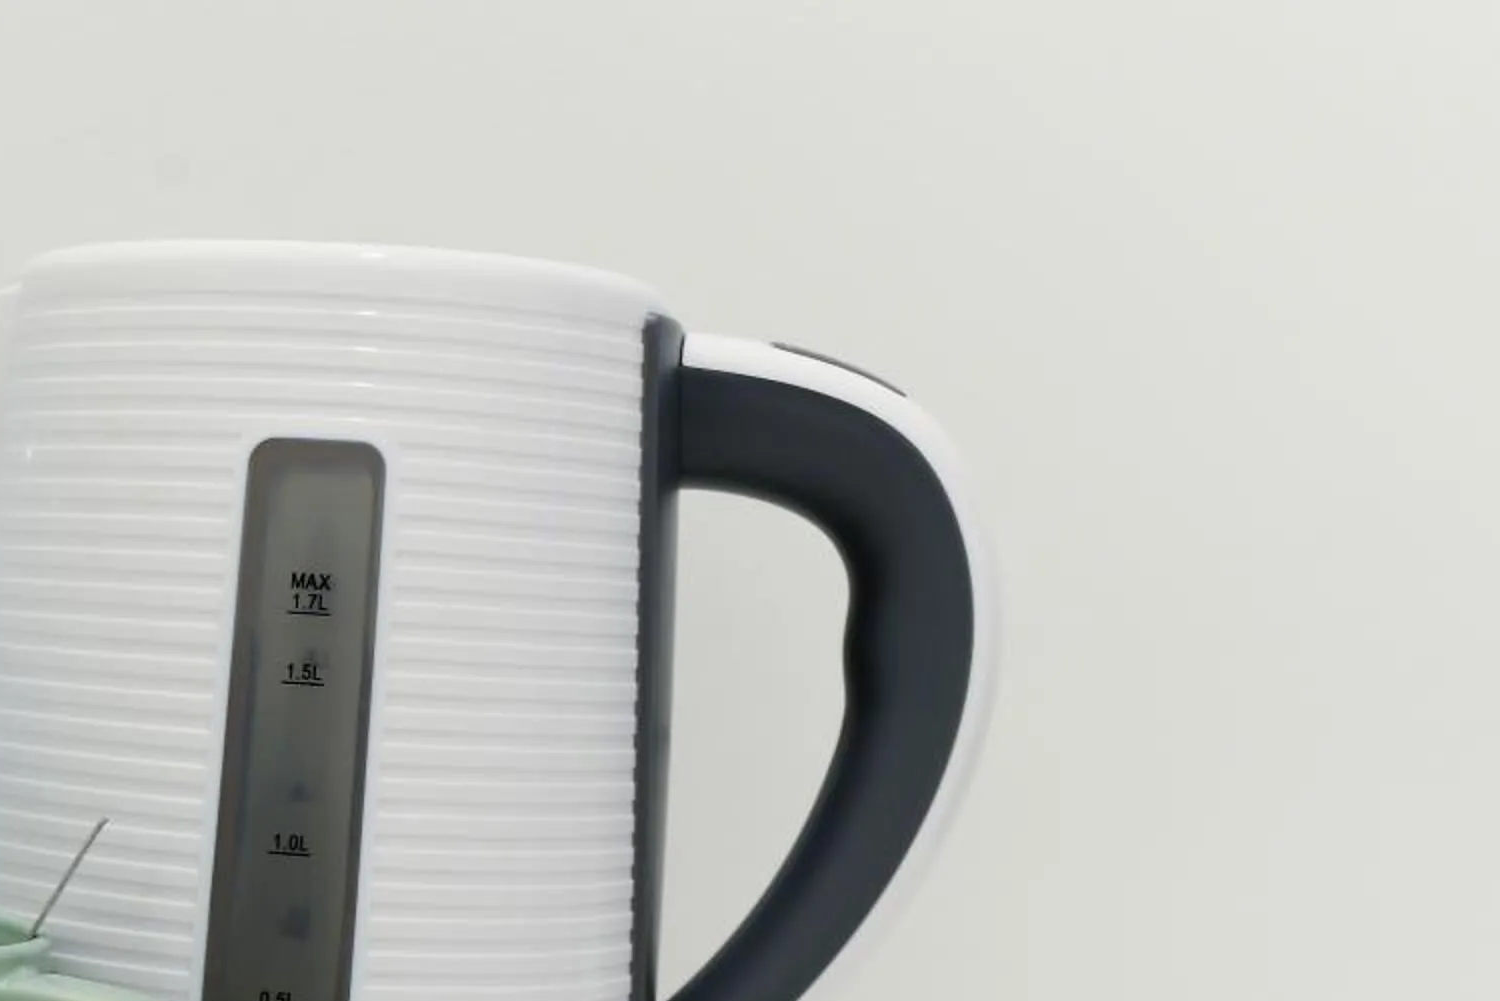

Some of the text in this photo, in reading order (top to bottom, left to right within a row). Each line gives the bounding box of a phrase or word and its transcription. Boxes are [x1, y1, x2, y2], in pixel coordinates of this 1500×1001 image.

[291, 573, 331, 590] MAX
[293, 593, 328, 611] 1.7L
[287, 663, 323, 681] 1.5L
[273, 833, 308, 851] 1.0L
